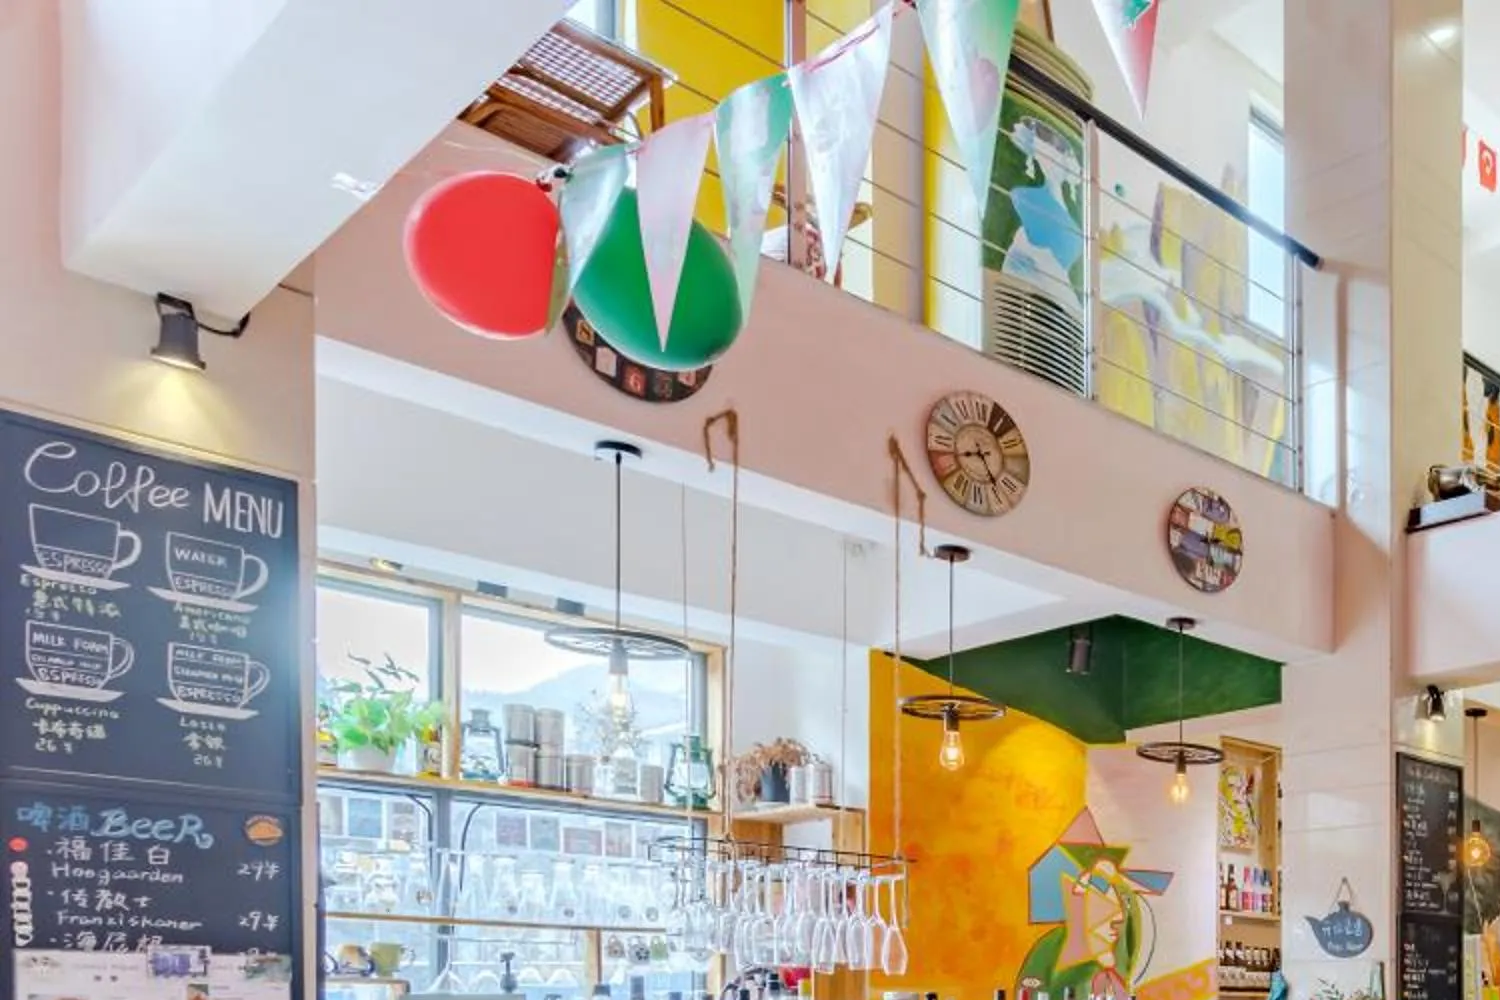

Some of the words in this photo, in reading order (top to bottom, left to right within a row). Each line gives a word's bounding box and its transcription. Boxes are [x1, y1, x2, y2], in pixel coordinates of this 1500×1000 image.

[24, 441, 191, 513] Coffee
[203, 482, 284, 538] MENU
[17, 802, 89, 832] 啤酒
[53, 838, 170, 865] 福佳白
[61, 888, 152, 911] 传教士
